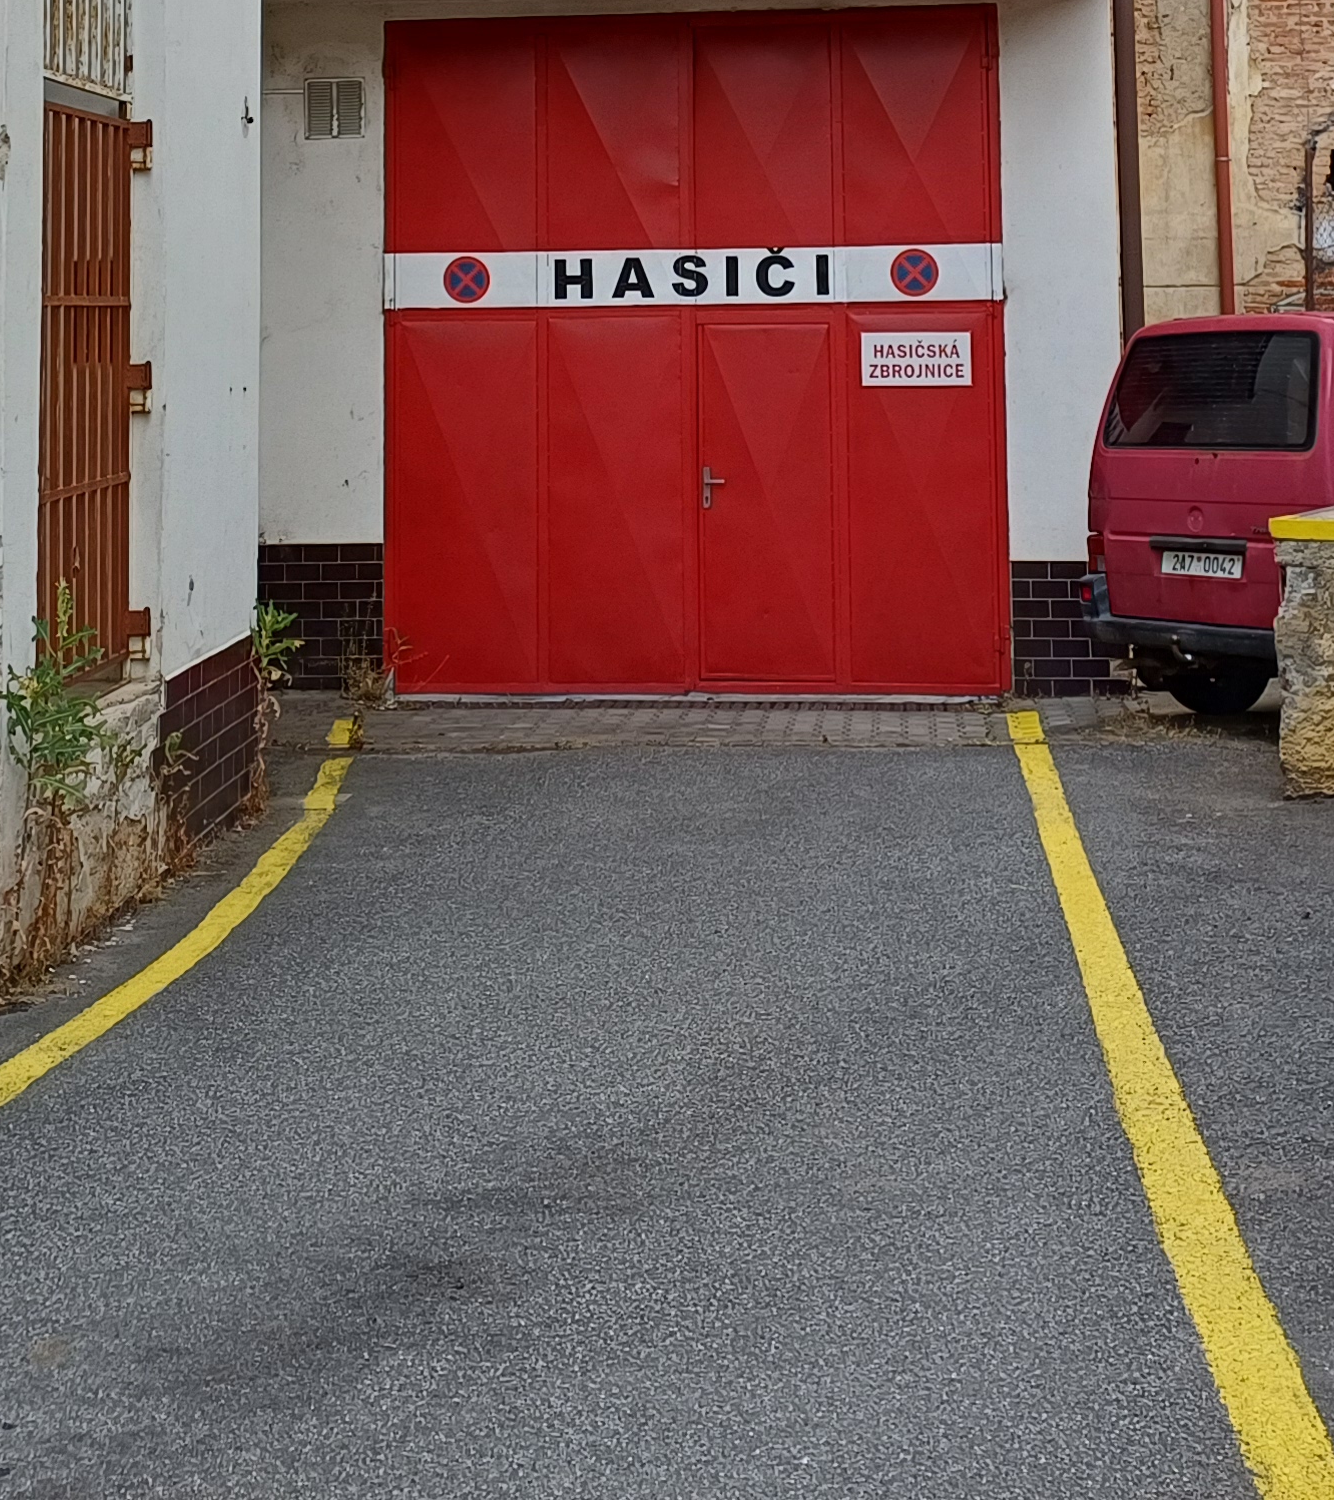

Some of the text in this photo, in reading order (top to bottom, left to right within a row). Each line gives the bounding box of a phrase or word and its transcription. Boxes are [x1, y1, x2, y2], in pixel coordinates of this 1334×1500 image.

[554, 247, 830, 300] HASIČI
[873, 339, 960, 359] HASIČSKÁ
[869, 363, 965, 379] ZBROJNICE
[1172, 553, 1236, 576] 2A7 0042
